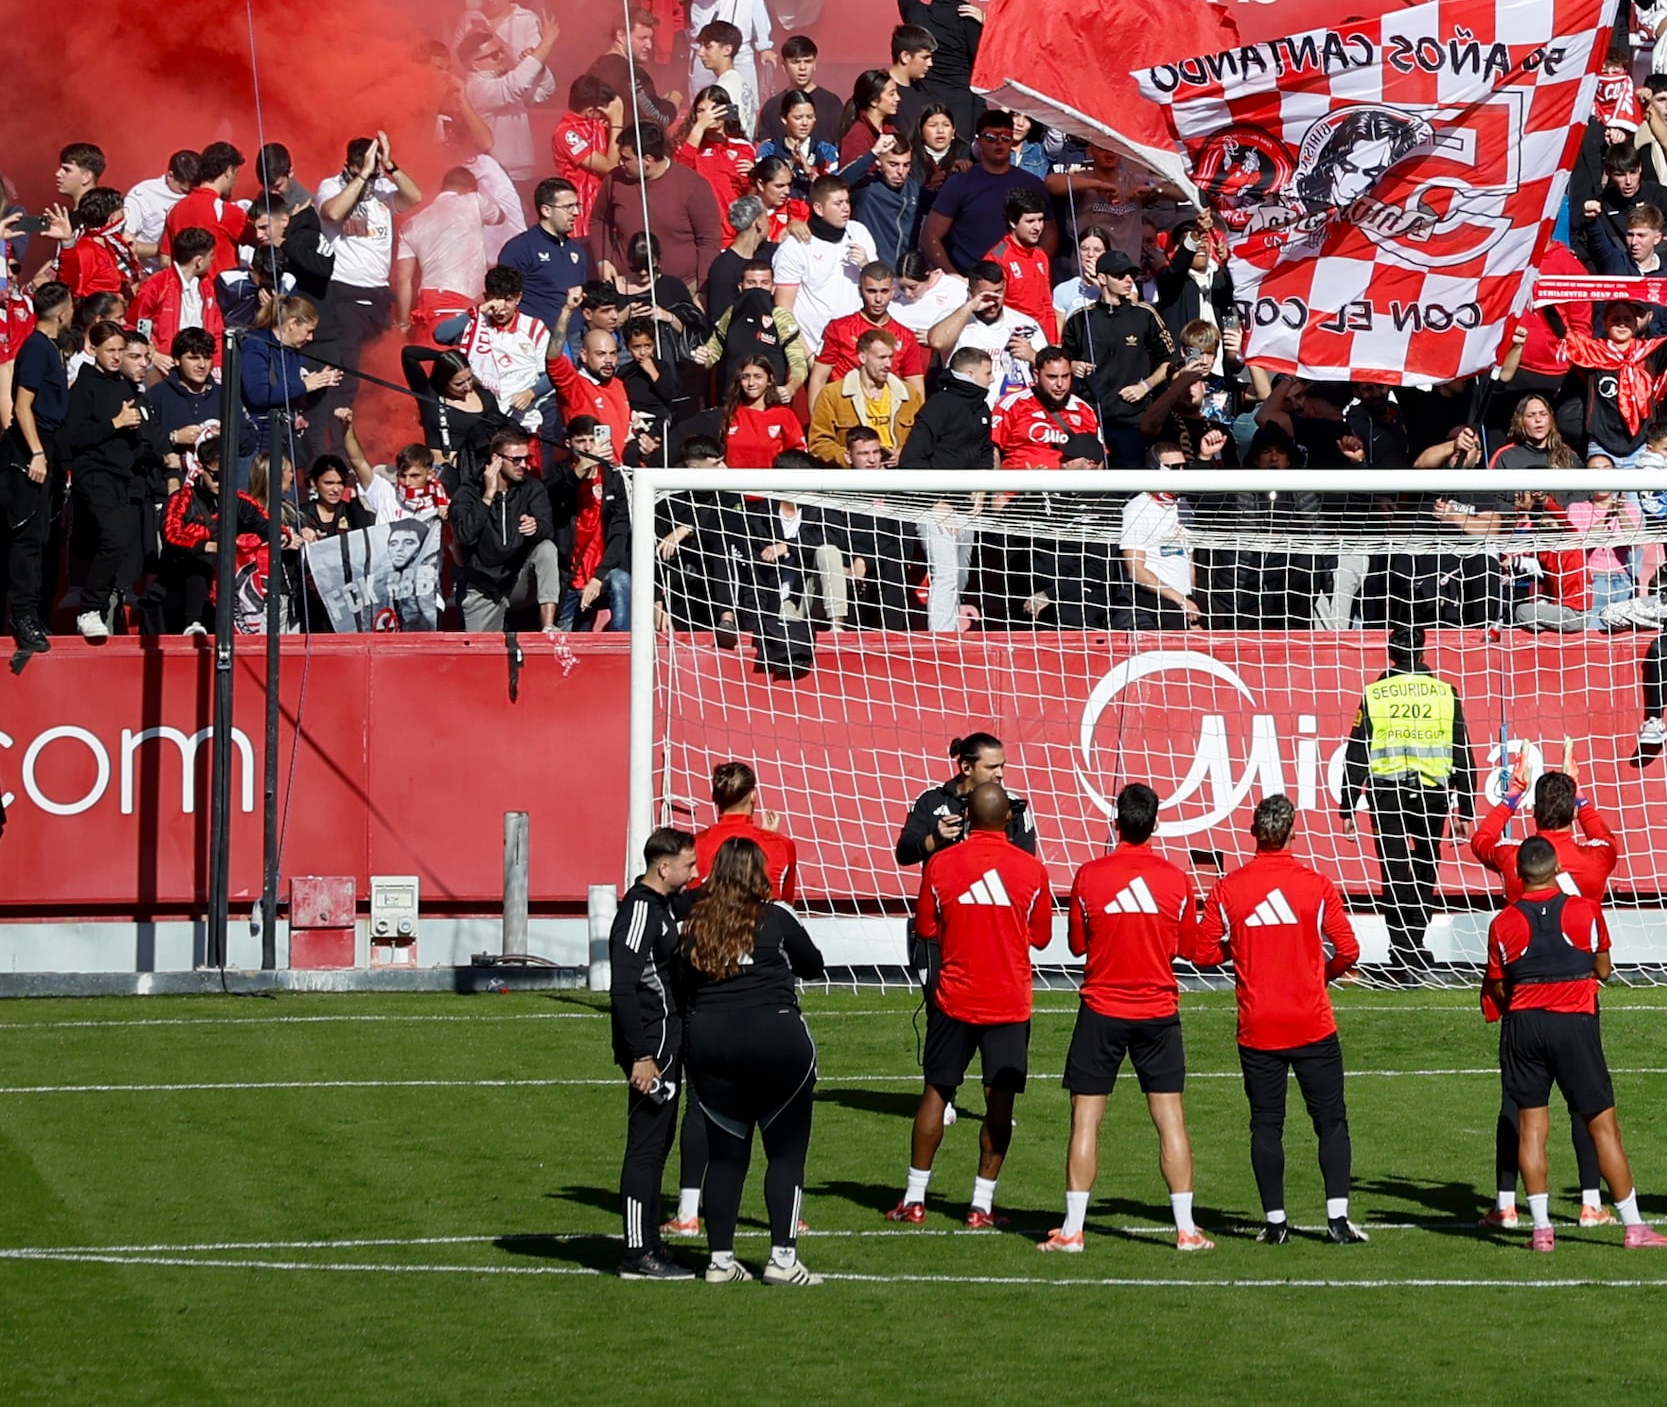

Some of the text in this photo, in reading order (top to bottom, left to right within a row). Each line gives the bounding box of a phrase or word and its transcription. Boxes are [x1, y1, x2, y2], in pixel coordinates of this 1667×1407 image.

[327, 573, 379, 622] FCK
[1371, 679, 1449, 700] SEGURIDAD
[1389, 703, 1434, 720] 2202
